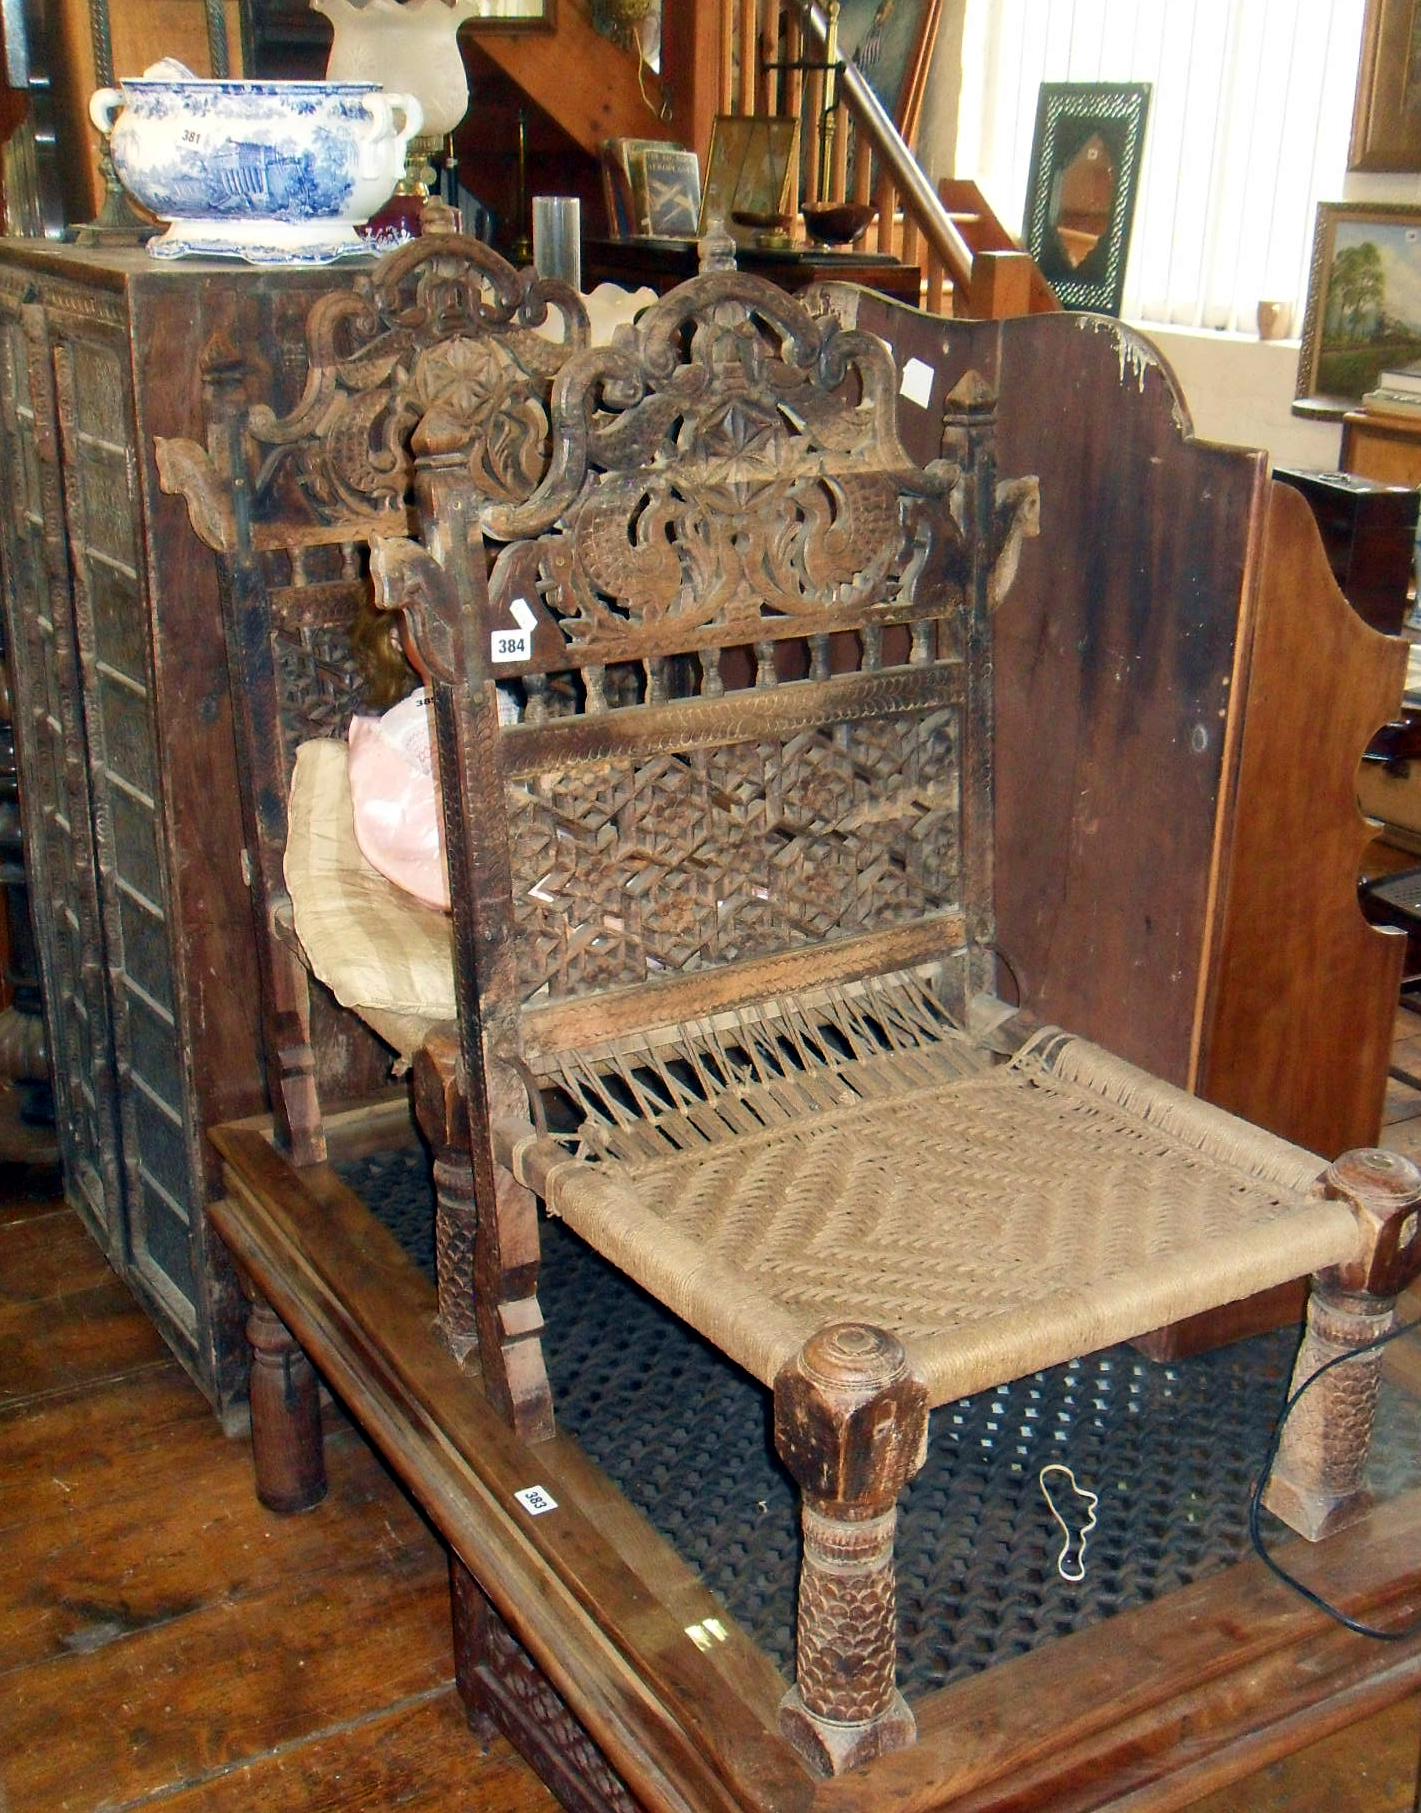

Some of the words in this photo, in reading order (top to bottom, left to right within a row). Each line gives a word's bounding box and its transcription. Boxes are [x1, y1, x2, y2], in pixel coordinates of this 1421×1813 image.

[181, 129, 201, 144] 381
[498, 638, 525, 653] 384
[525, 1491, 547, 1508] 383
